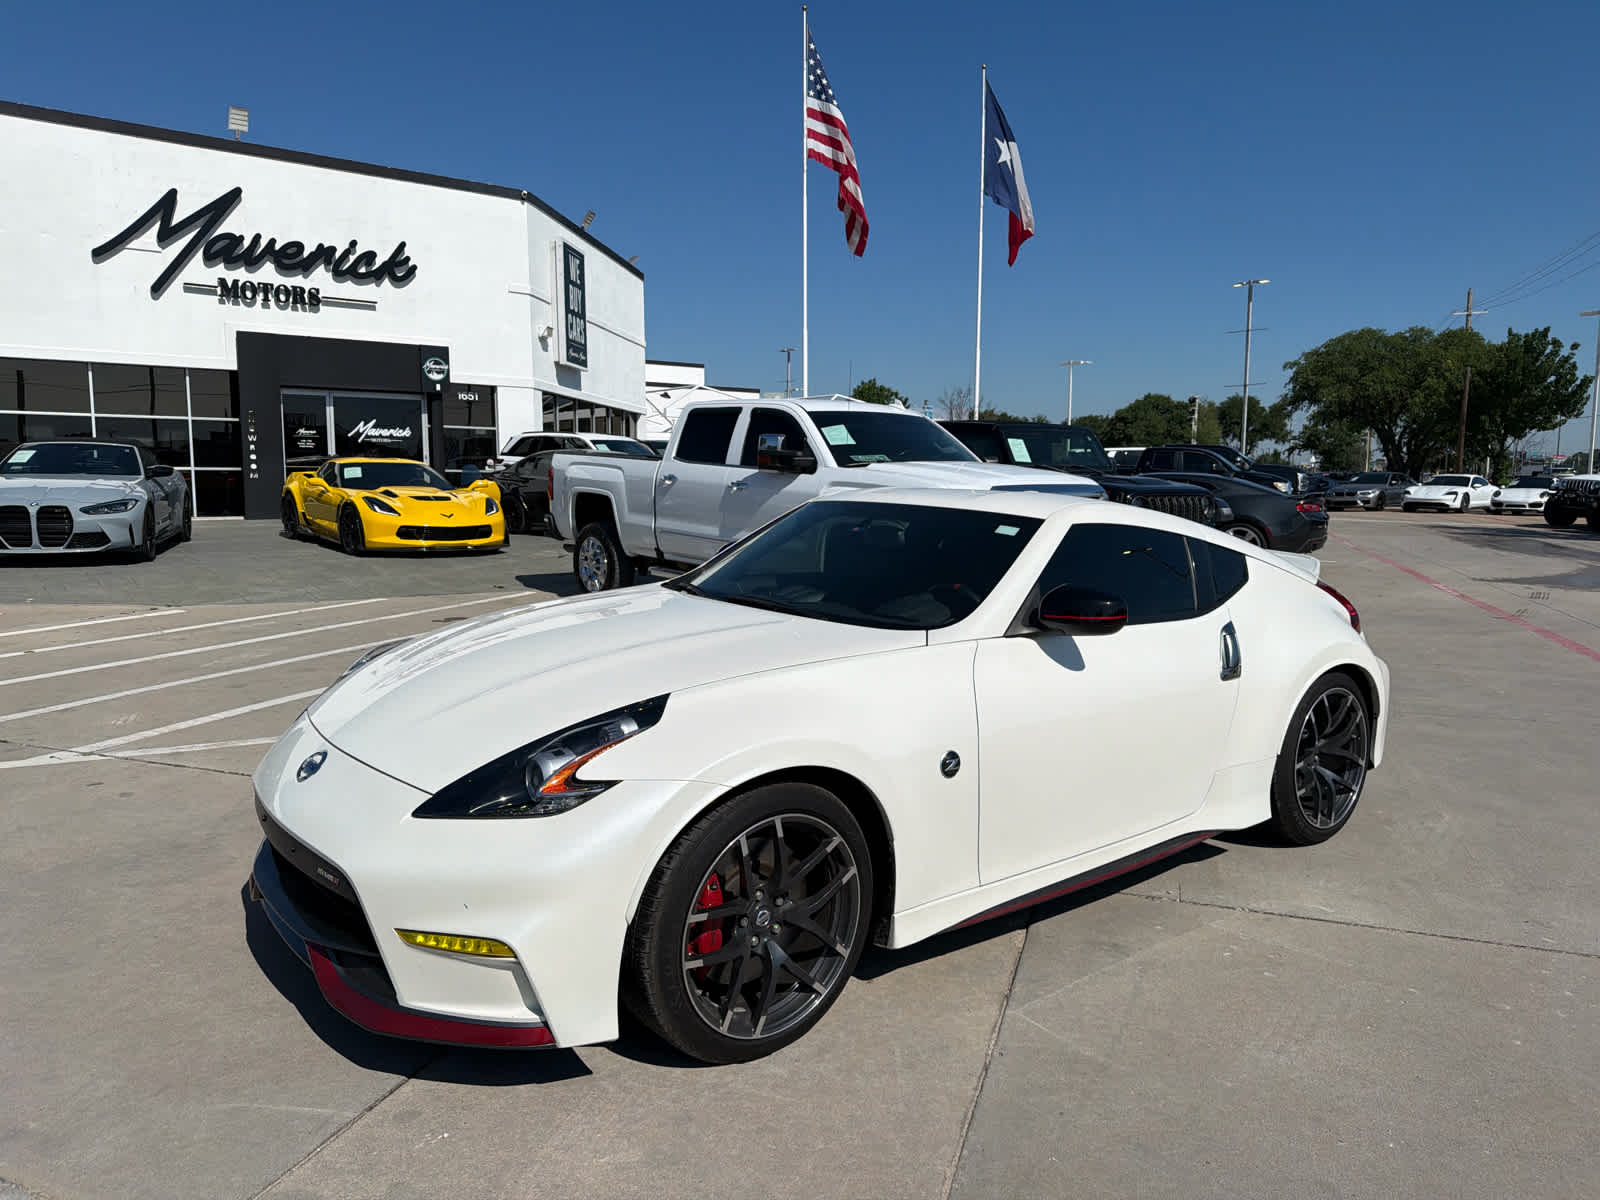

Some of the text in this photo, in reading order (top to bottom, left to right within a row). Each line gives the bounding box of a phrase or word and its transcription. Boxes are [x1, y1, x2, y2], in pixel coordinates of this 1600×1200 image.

[91, 186, 418, 301] Maverick
[568, 254, 580, 284] WE
[216, 277, 321, 309] MOTORS
[569, 284, 582, 314] BUY
[567, 313, 585, 344] CARS
[457, 392, 479, 401] 1651
[347, 418, 412, 443] Maverick
